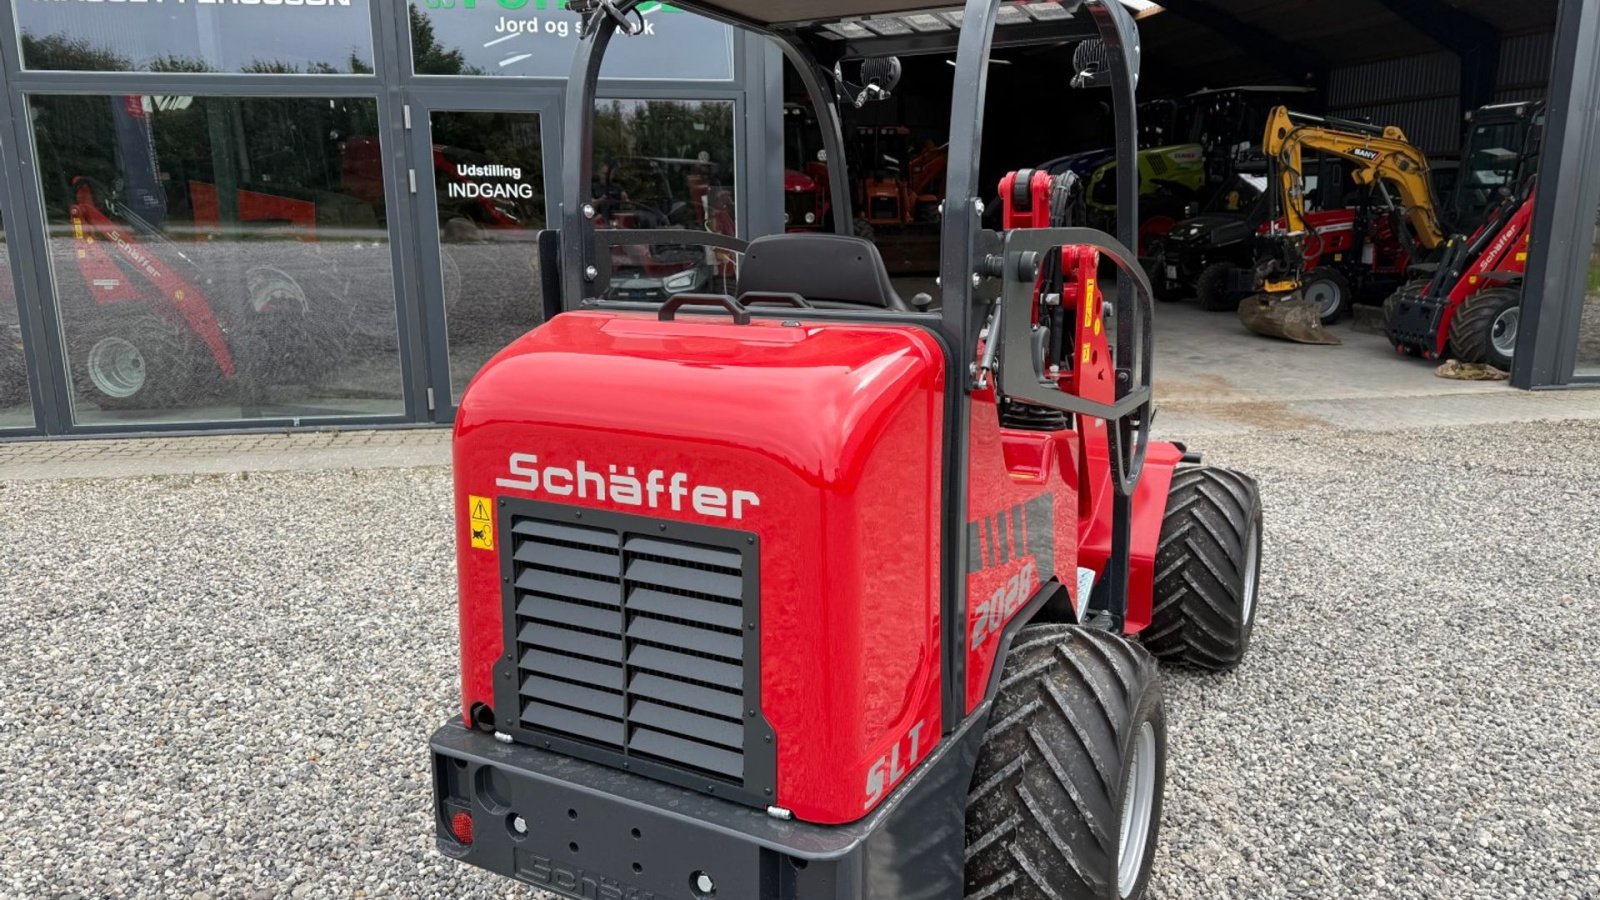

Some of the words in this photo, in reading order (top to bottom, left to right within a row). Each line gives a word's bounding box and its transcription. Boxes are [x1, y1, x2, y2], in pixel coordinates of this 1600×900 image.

[495, 17, 538, 33] Jord
[545, 20, 569, 37] og
[448, 183, 533, 198] INDGANG
[457, 164, 521, 179] Udstilling
[496, 453, 760, 519] Schäffer
[971, 564, 1032, 650] 2028
[864, 720, 925, 810] SLT
